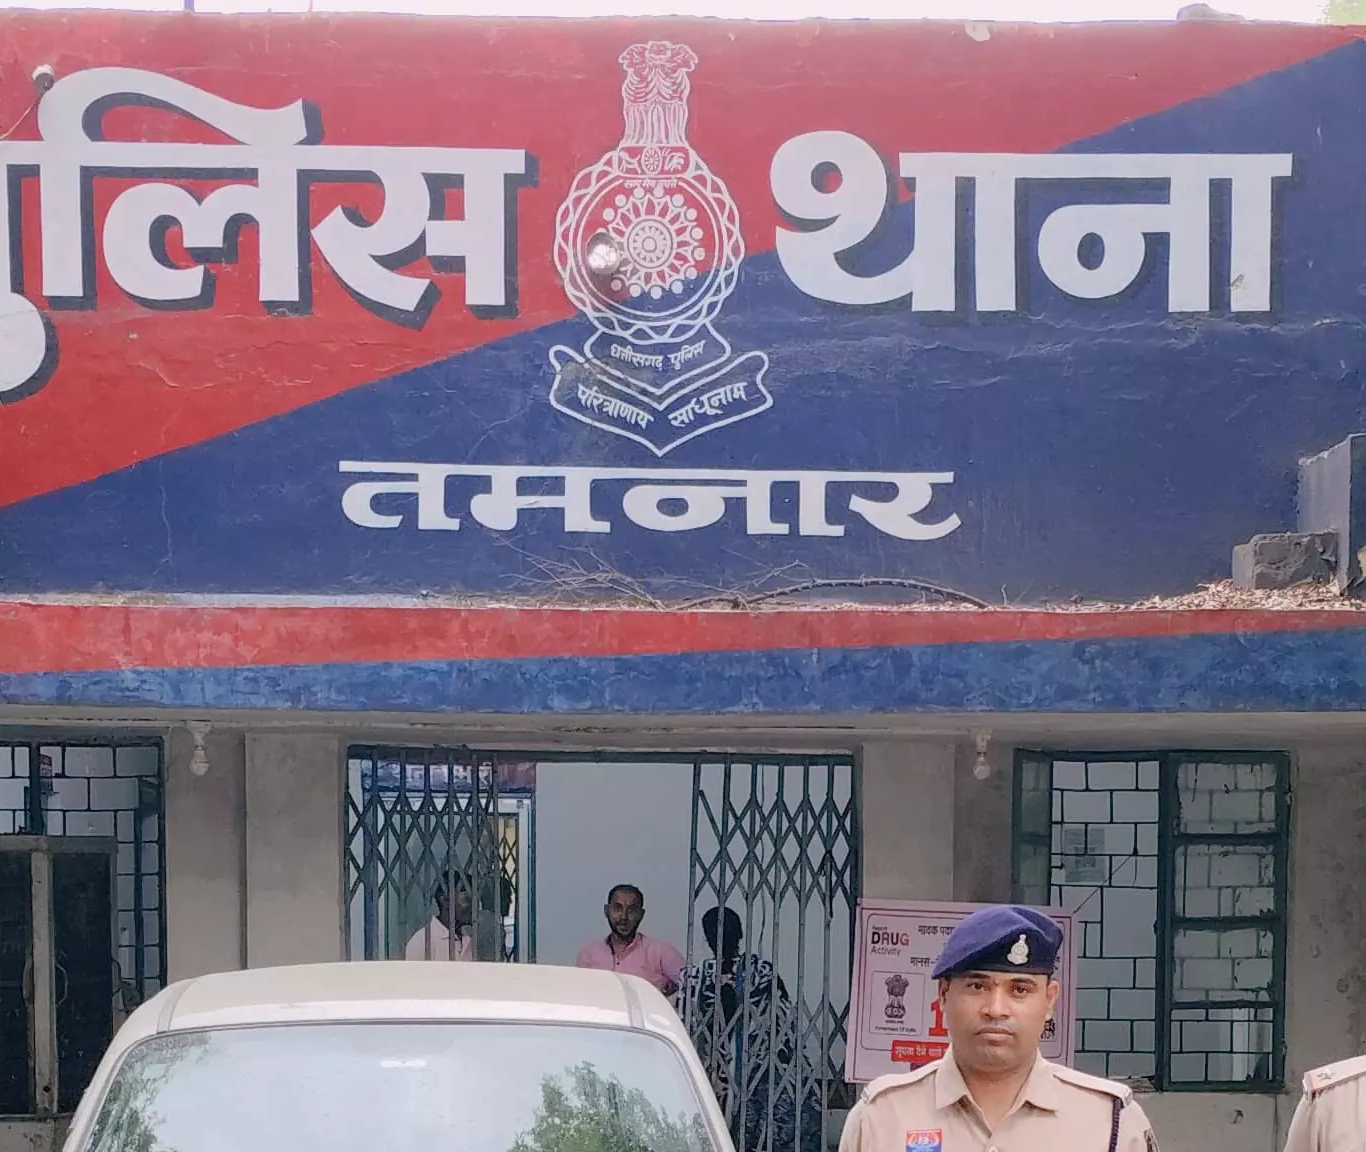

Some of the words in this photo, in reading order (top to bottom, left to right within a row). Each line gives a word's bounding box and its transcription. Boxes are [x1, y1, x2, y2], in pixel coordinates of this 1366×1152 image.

[772, 130, 1294, 314] थाना
[667, 339, 707, 370] पुलिस
[340, 461, 962, 540] तमनार
[870, 946, 901, 957] Activity
[871, 932, 910, 947] DRUG
